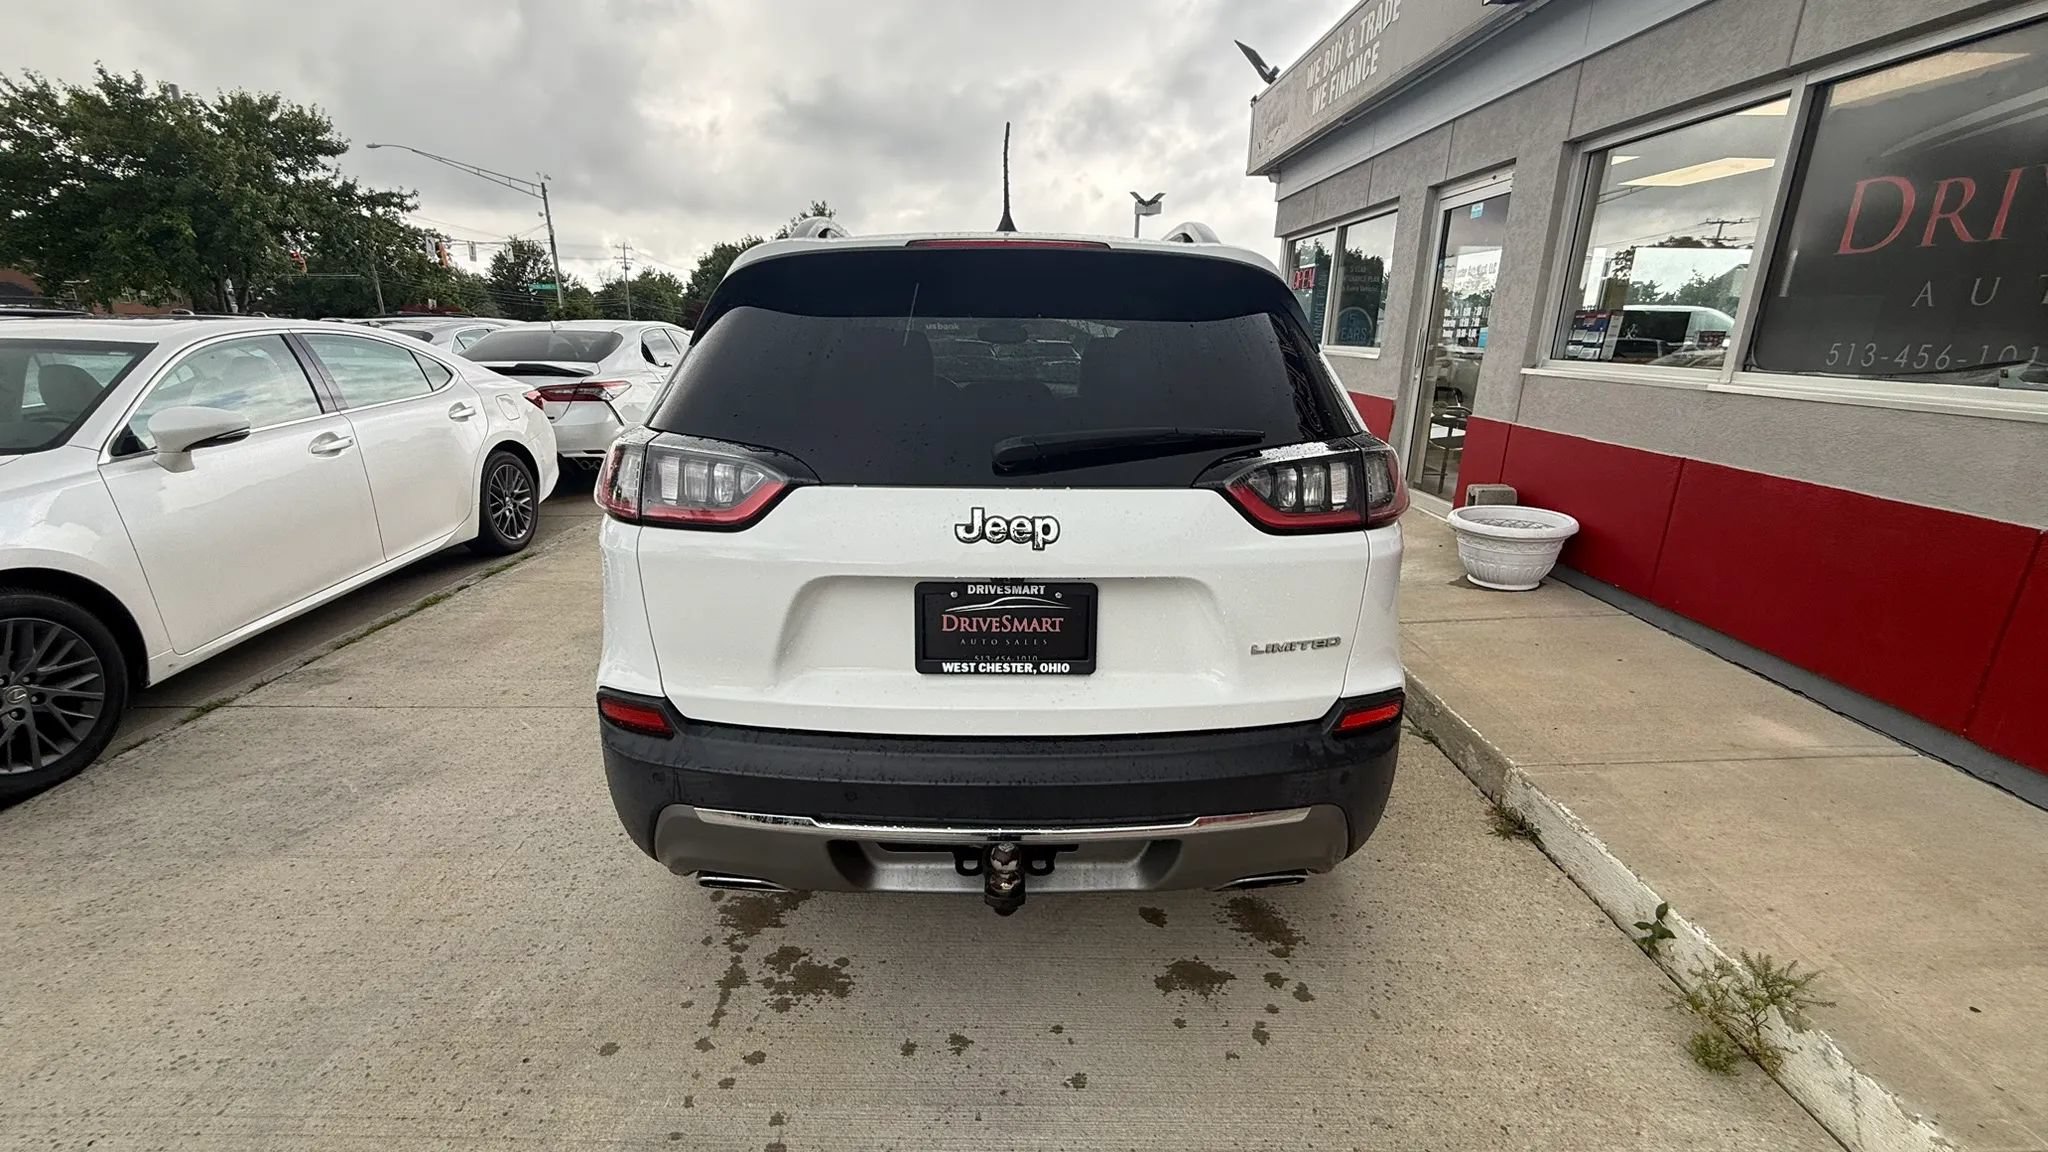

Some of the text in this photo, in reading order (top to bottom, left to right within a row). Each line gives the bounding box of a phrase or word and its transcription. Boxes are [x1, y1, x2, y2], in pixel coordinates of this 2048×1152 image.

[1306, 0, 1401, 90] WE BUY & TRADE
[1312, 40, 1380, 116] WE FINANCE
[1833, 162, 2048, 255] DRI
[954, 506, 1061, 551] Jeep
[967, 584, 1046, 595] DRIVESMART
[960, 638, 1048, 646] AUTO SALES
[1250, 636, 1342, 655] LIMITED
[942, 662, 1071, 675] WEST CHESTER, OHIO
